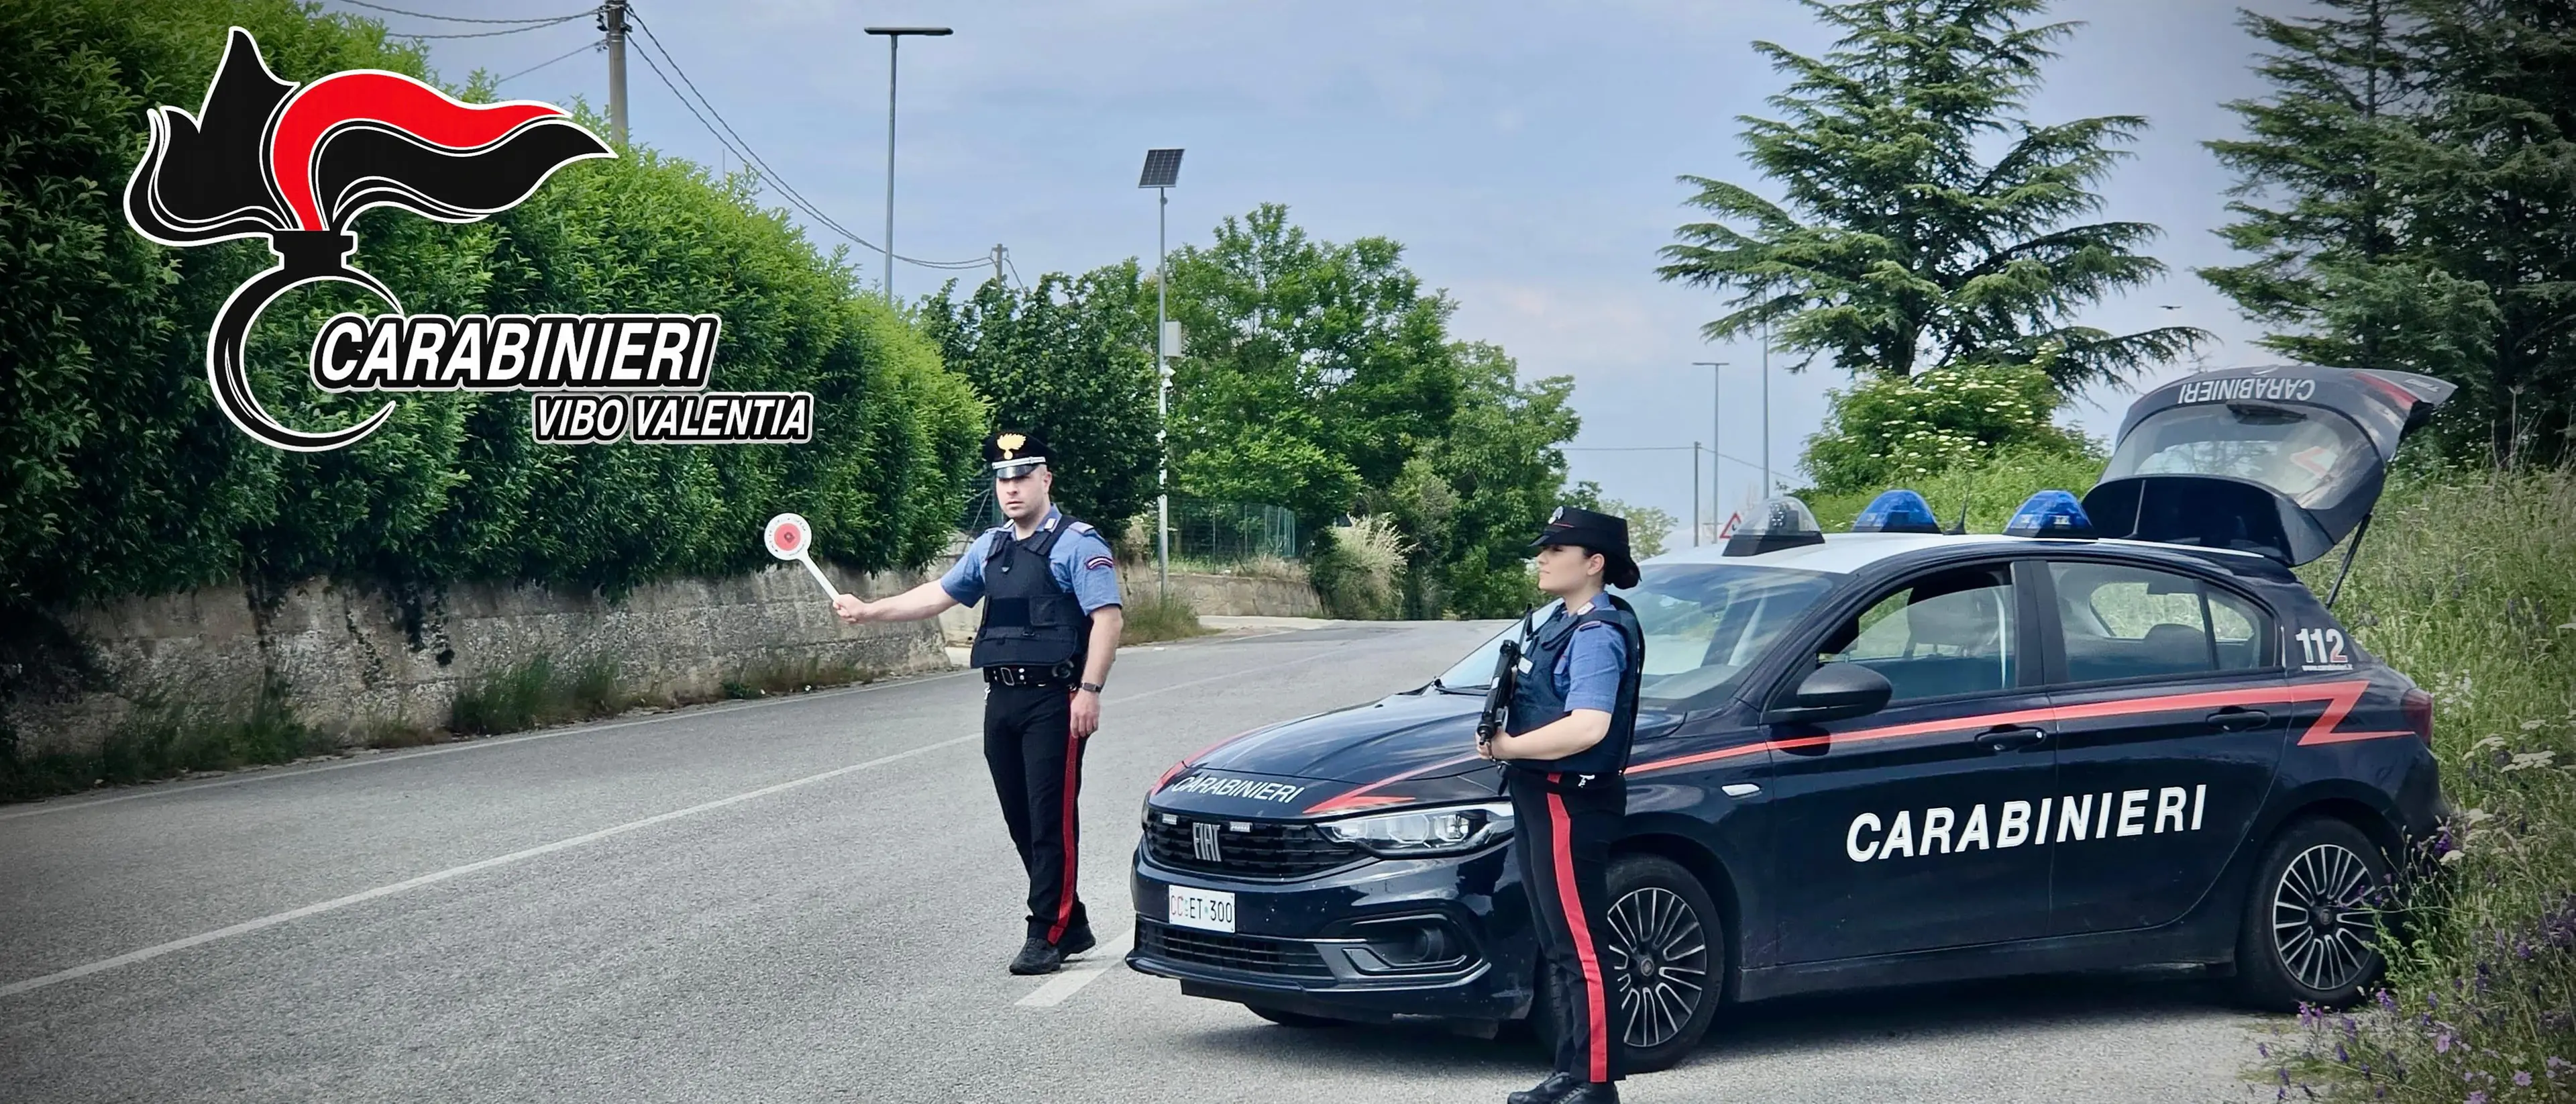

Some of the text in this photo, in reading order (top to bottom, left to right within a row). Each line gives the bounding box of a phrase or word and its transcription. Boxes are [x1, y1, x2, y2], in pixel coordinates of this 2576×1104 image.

[2178, 378, 2316, 404] CARABINIERI
[2296, 628, 2349, 663] 112
[1171, 776, 1305, 803] CARABINIERI
[1846, 784, 2206, 862] CARABINIERI
[1193, 822, 1222, 862] FIAT
[1210, 900, 1232, 923] 300
